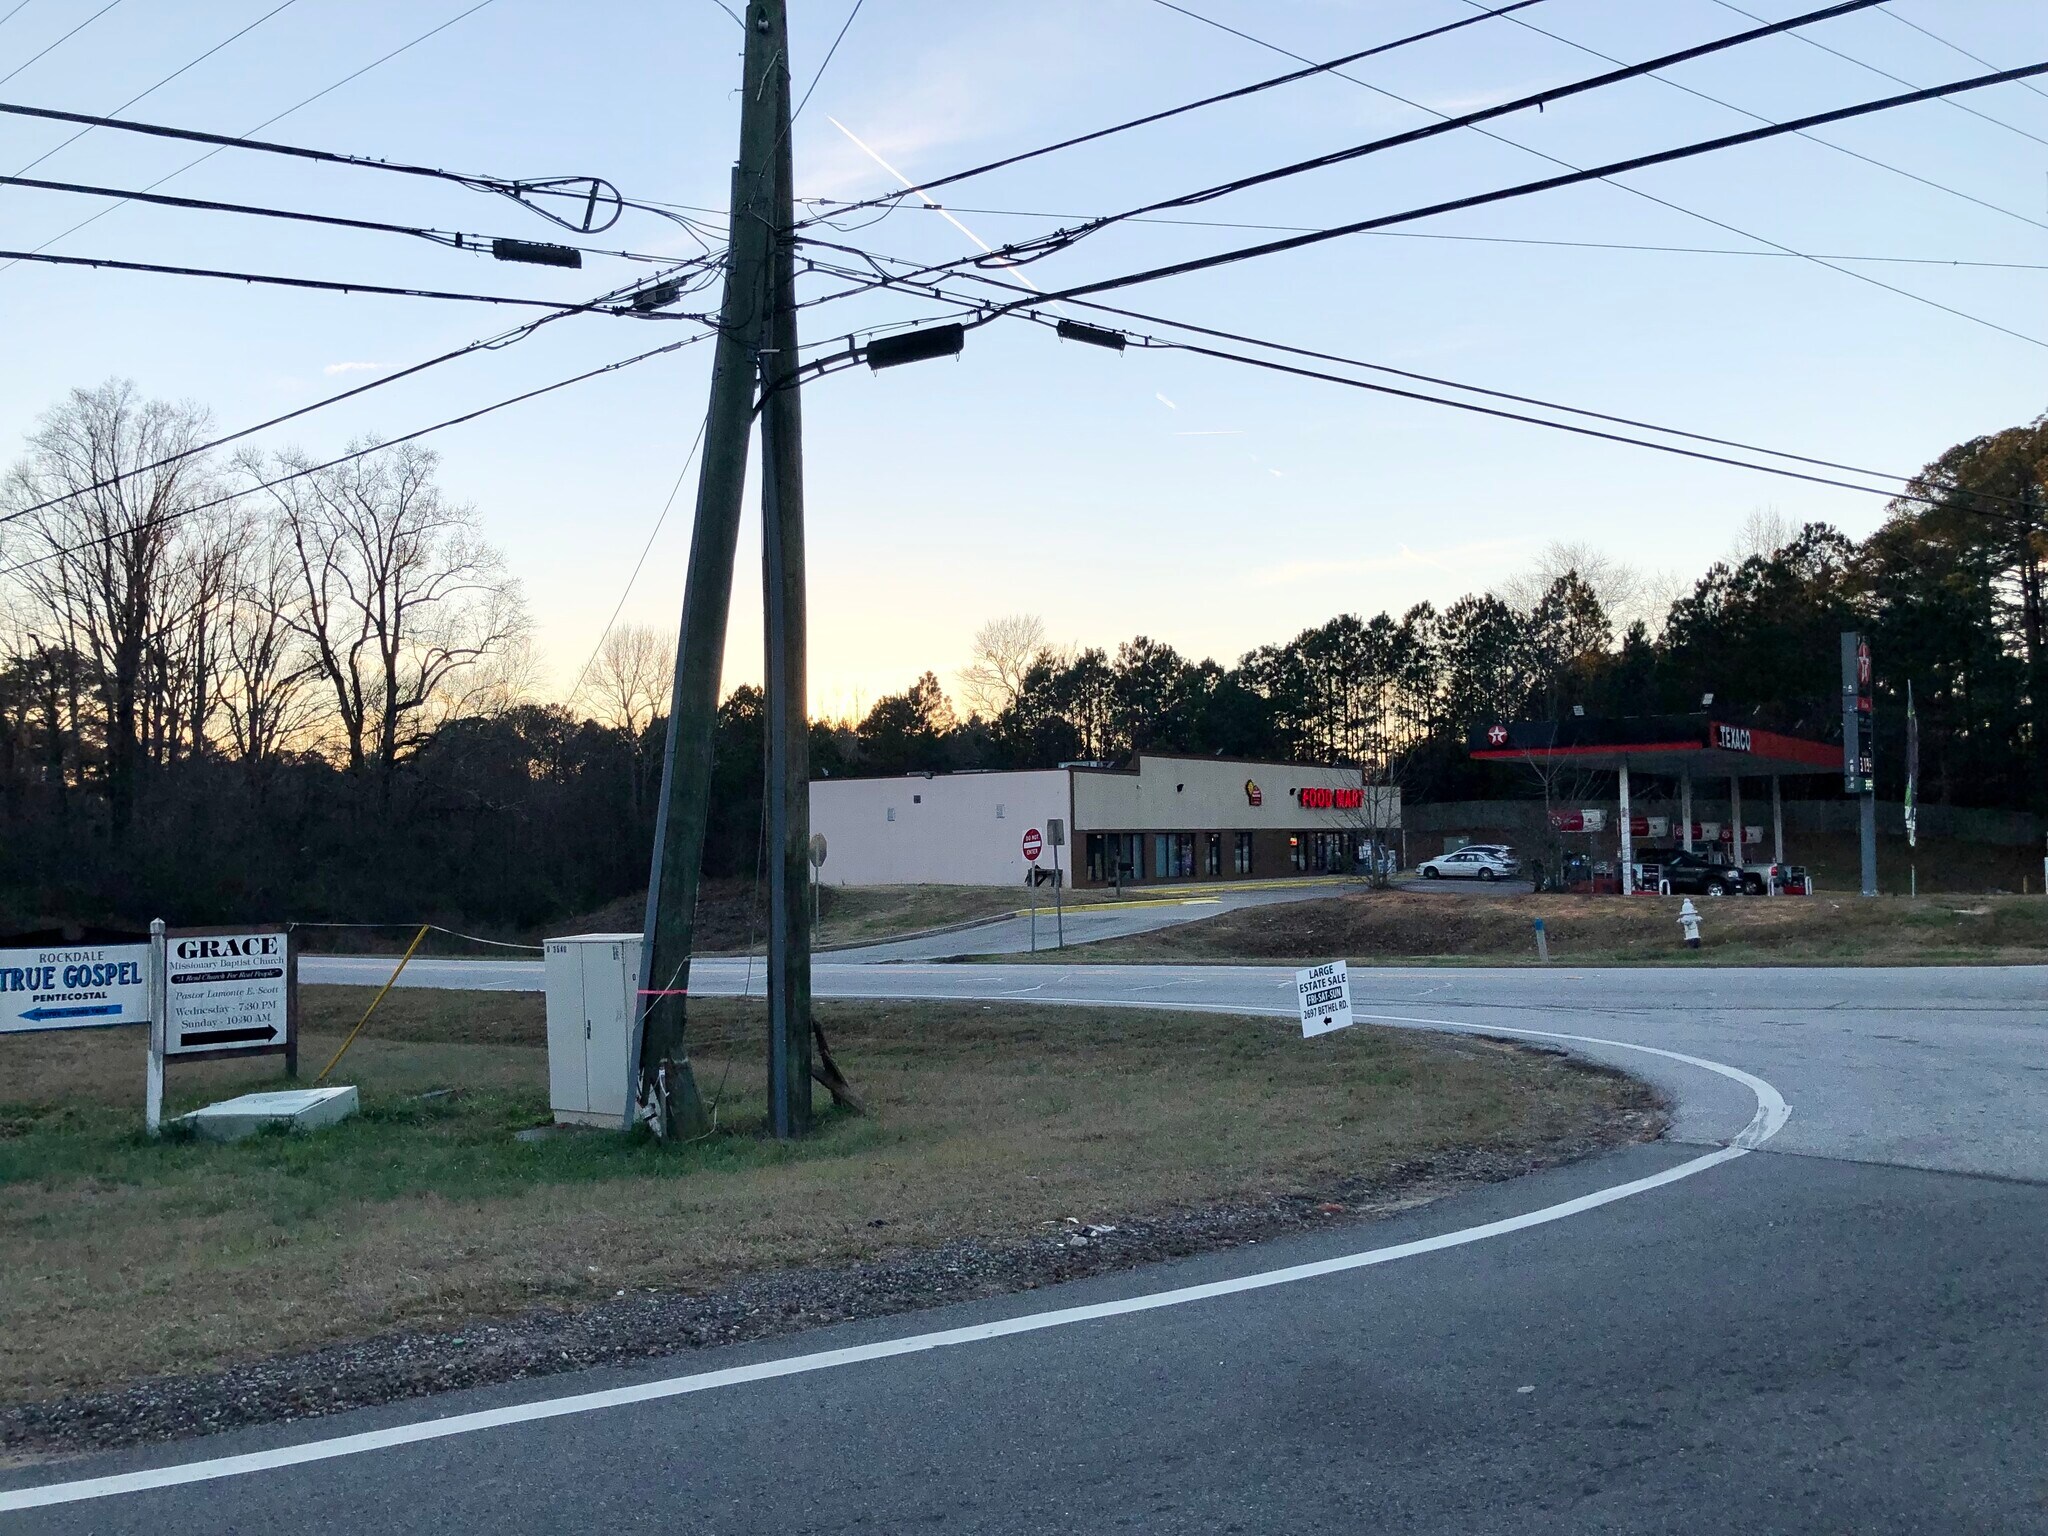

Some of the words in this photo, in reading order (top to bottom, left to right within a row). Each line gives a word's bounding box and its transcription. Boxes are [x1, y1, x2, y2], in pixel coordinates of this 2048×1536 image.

[1720, 725, 1750, 751] TEXACO
[1302, 787, 1332, 807] FOOD
[1335, 788, 1364, 808] MART
[177, 936, 278, 959] GRACE
[39, 951, 105, 963] ROCKDALE
[169, 961, 218, 970] Missionary
[220, 958, 251, 968] Baptist
[252, 957, 284, 965] Church
[0, 966, 56, 992] TRUE
[63, 962, 143, 988] GOSPEL
[185, 974, 201, 982] Real
[201, 973, 225, 981] Church
[1308, 965, 1334, 979] LARGE
[1299, 979, 1327, 993] ESTATE
[1327, 973, 1347, 986] SALE
[32, 992, 108, 1003] PENTECOSTAL
[175, 991, 205, 1000] Pastor
[207, 989, 245, 998] Lamonte
[246, 987, 255, 995] E.
[257, 986, 279, 995] Scott
[175, 1005, 230, 1016] Wednesday
[238, 1002, 259, 1011] 7:30
[261, 1000, 277, 1009] PM
[1304, 1008, 1317, 1019] 2697
[1318, 1001, 1338, 1016] BETHEL
[1338, 999, 1349, 1010] RD.
[181, 1018, 218, 1029] Sunday
[226, 1015, 253, 1025] 10:30
[254, 1013, 271, 1023] AM
